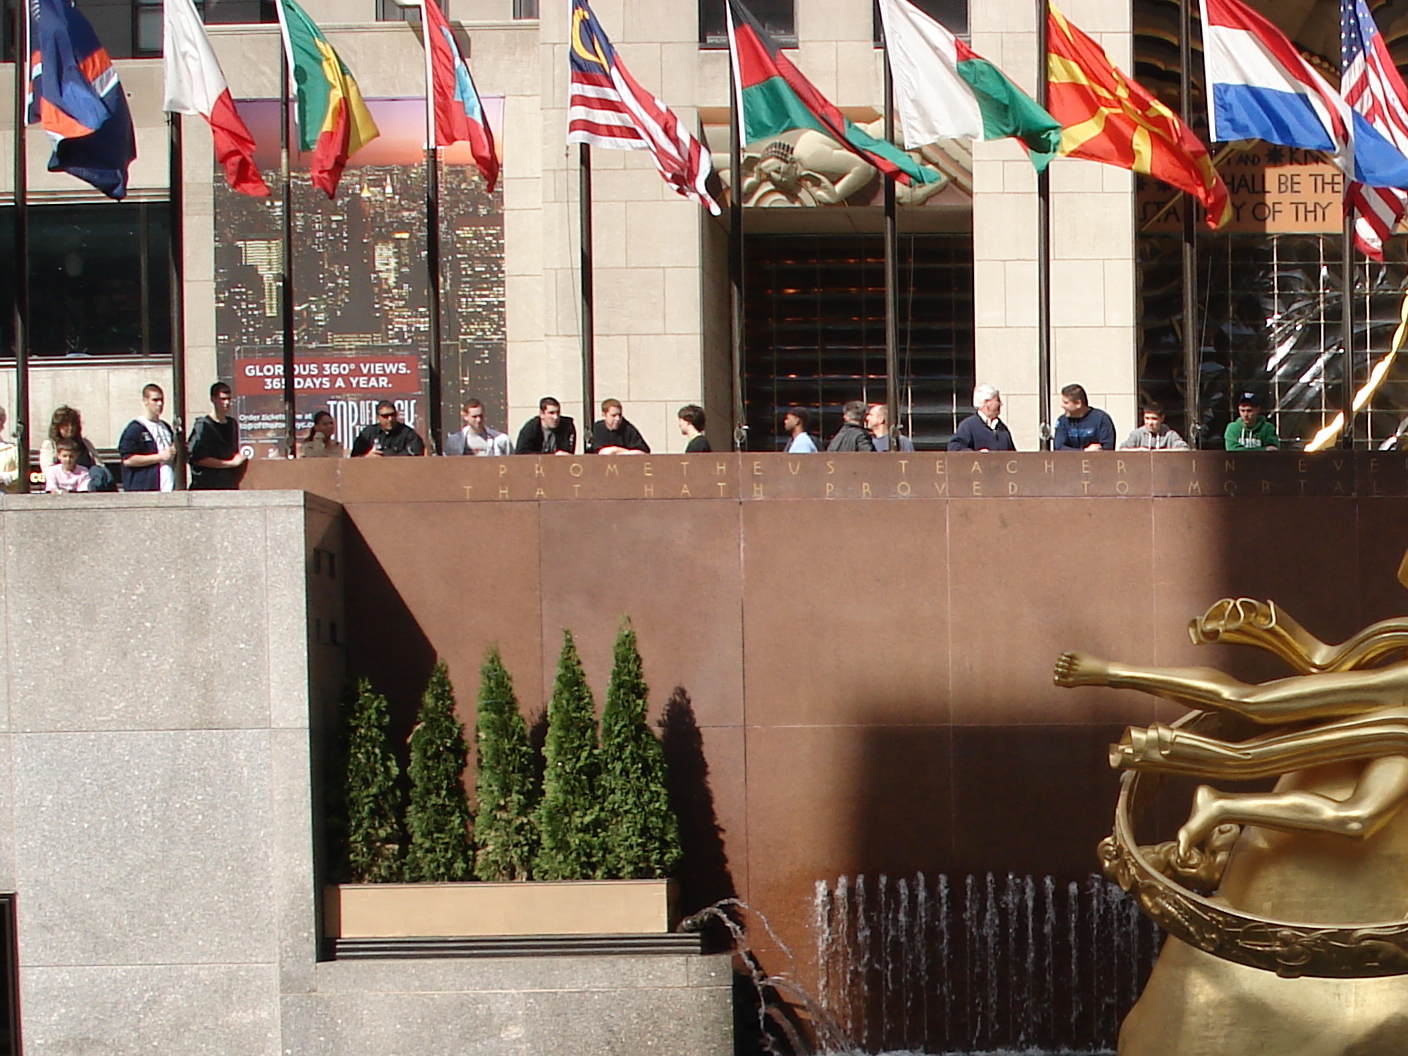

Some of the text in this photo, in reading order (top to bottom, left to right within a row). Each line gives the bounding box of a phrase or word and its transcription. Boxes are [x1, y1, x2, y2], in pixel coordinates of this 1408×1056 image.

[1222, 173, 1342, 194] HALL BE THE
[1252, 201, 1283, 222] OF
[1289, 201, 1333, 222] THY
[244, 363, 319, 377] GLOROUS
[359, 362, 411, 375] VIEWS.
[293, 377, 331, 389] DAYS
[334, 377, 346, 388] A
[349, 376, 393, 388] YEAR.
[498, 461, 836, 478] PROMETHEUS
[898, 460, 1127, 475] TEACHER
[1191, 459, 1236, 473] IN
[463, 484, 582, 500] THAT
[644, 483, 764, 499] HATH
[825, 481, 1018, 497] PROVED
[1081, 480, 1130, 495] TO
